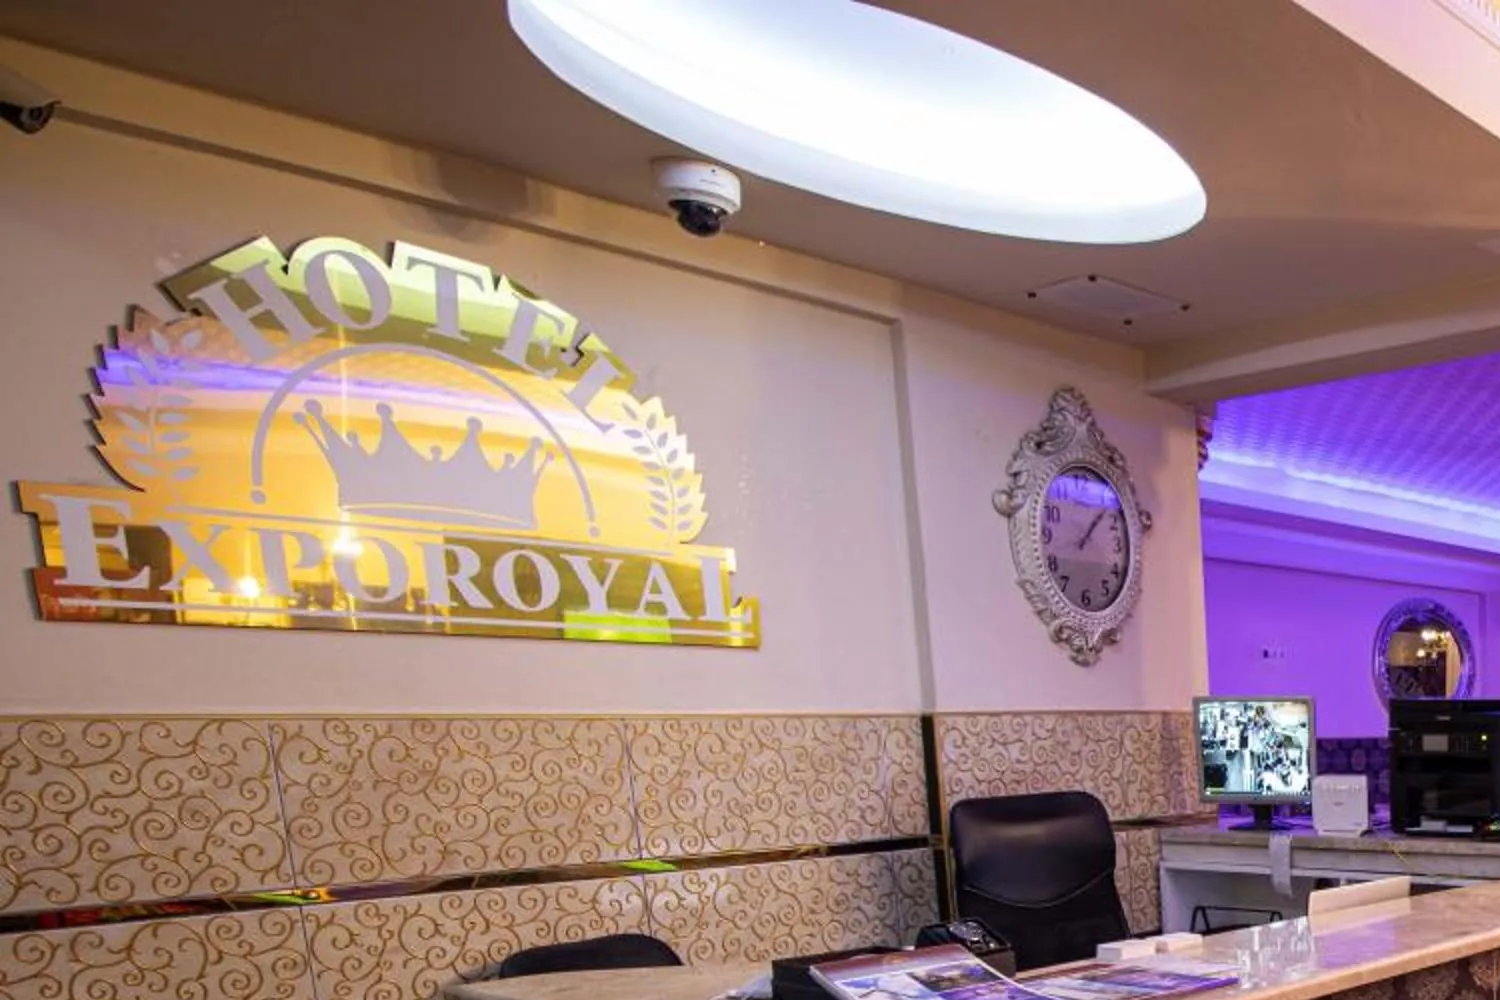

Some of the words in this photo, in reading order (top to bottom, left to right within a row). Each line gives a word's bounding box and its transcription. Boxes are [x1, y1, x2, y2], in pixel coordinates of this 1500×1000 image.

[186, 249, 627, 433] HOTEL
[1044, 504, 1061, 523] 10
[1042, 527, 1053, 544] 9
[1047, 553, 1058, 573] 8
[1110, 562, 1119, 579] 4
[1060, 574, 1070, 593] 7
[1101, 579, 1110, 596] 5
[1081, 588, 1091, 607] 6
